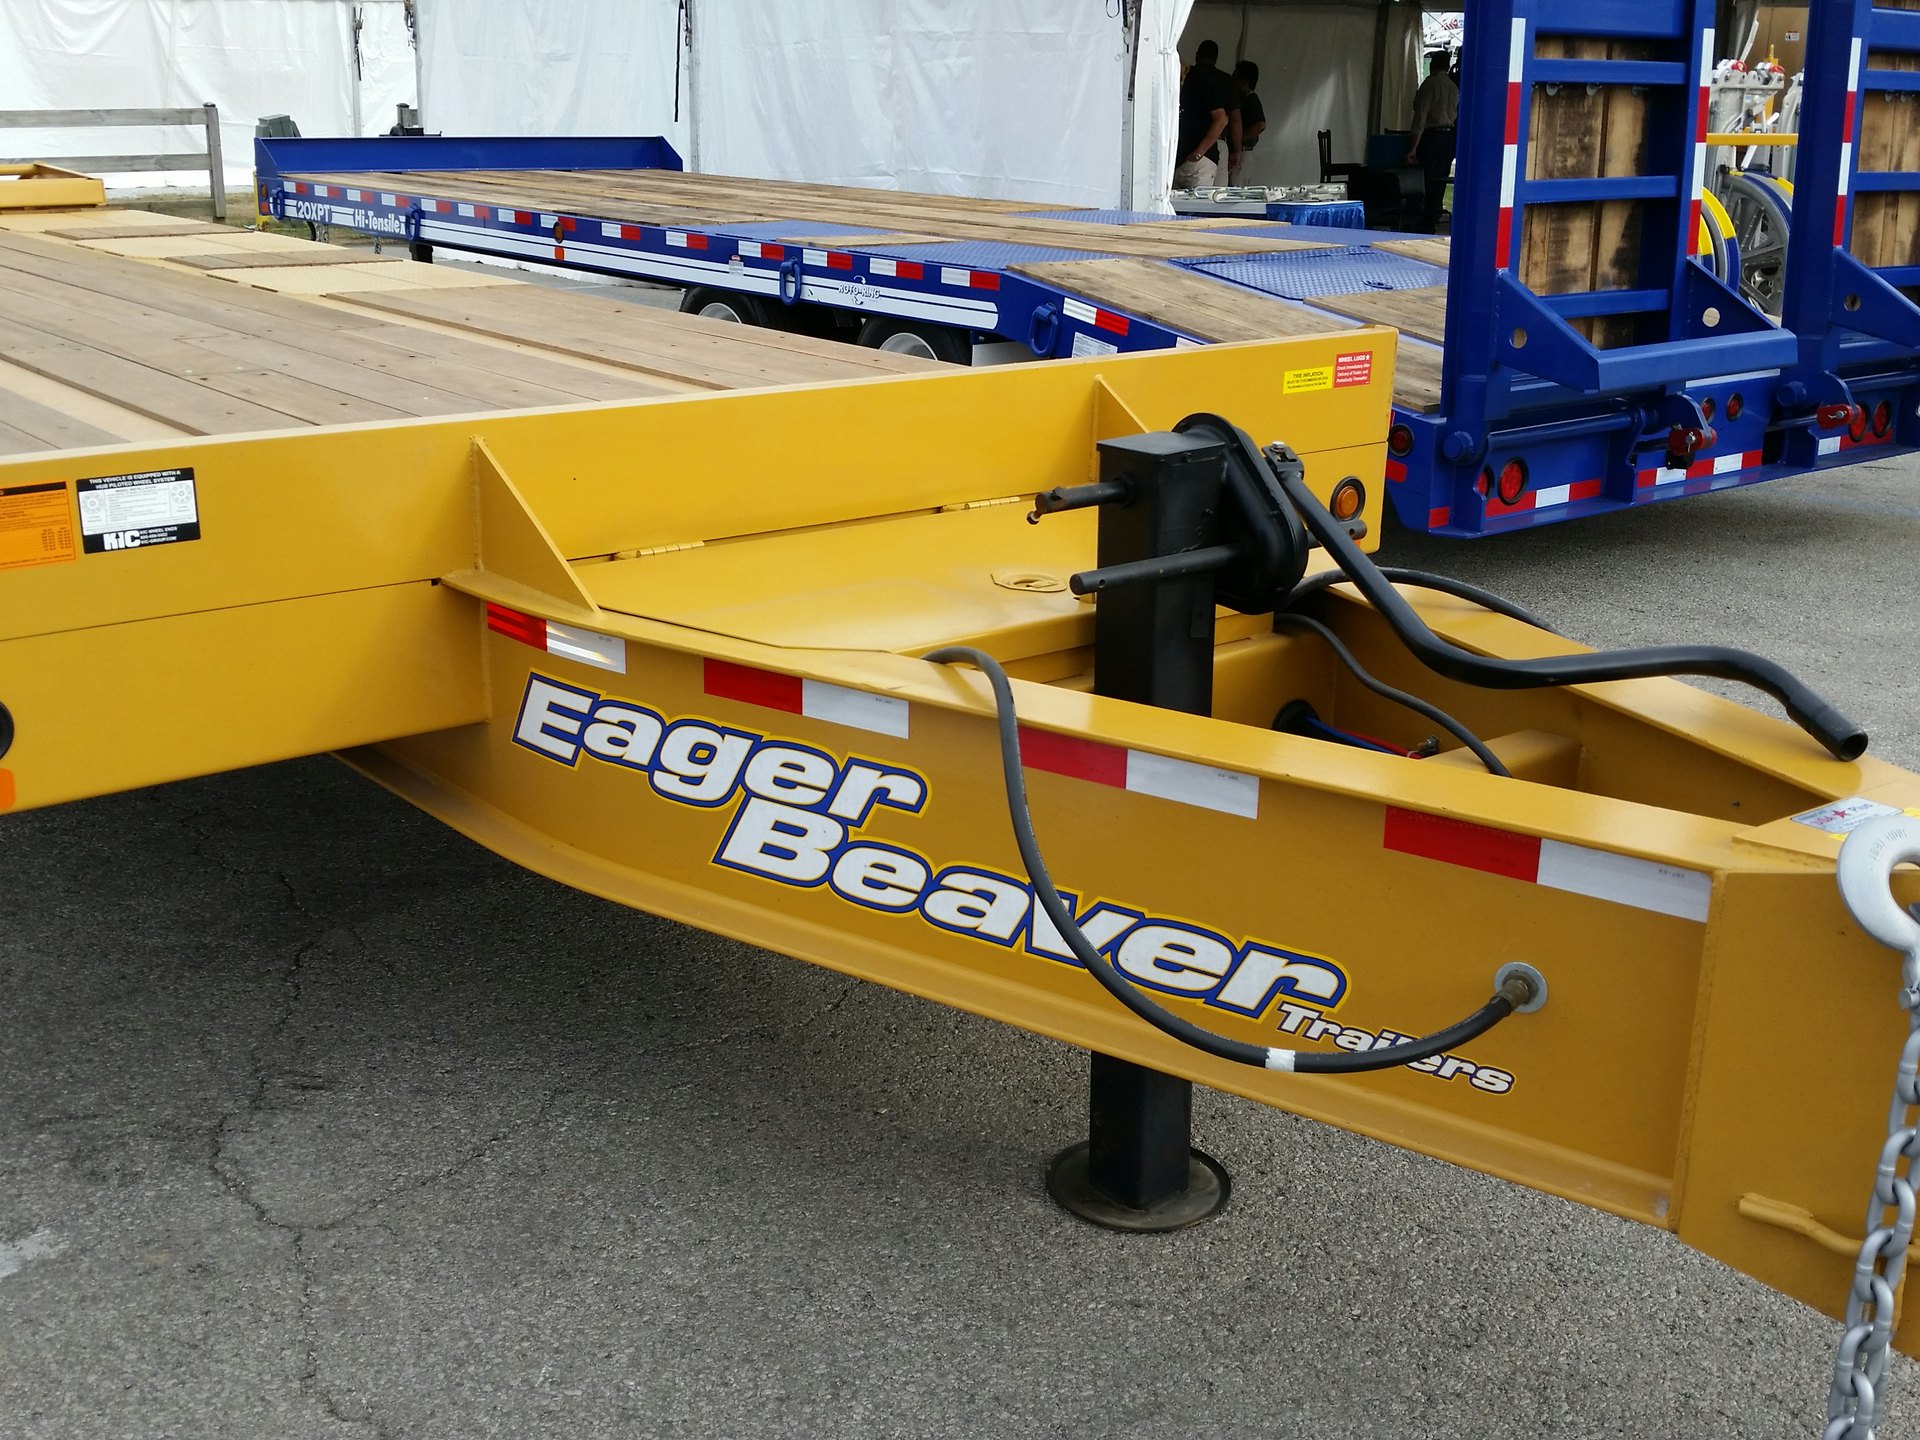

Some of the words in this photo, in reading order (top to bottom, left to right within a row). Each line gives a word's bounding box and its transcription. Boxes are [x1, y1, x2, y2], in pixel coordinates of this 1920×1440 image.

[297, 200, 330, 222] 20XPT
[354, 208, 400, 234] Hi-Tensile
[838, 284, 880, 299] ROTO-RING
[103, 475, 126, 484] VEHICLE
[133, 472, 161, 480] EQUIPPED
[109, 480, 133, 488] PILOTED
[133, 478, 152, 486] WHEEL
[153, 476, 176, 484] SYSTEM
[103, 530, 141, 551] KIC
[512, 671, 928, 828] Eager
[711, 791, 1347, 1018] Beaver
[1276, 1000, 1515, 1094] Traiers
